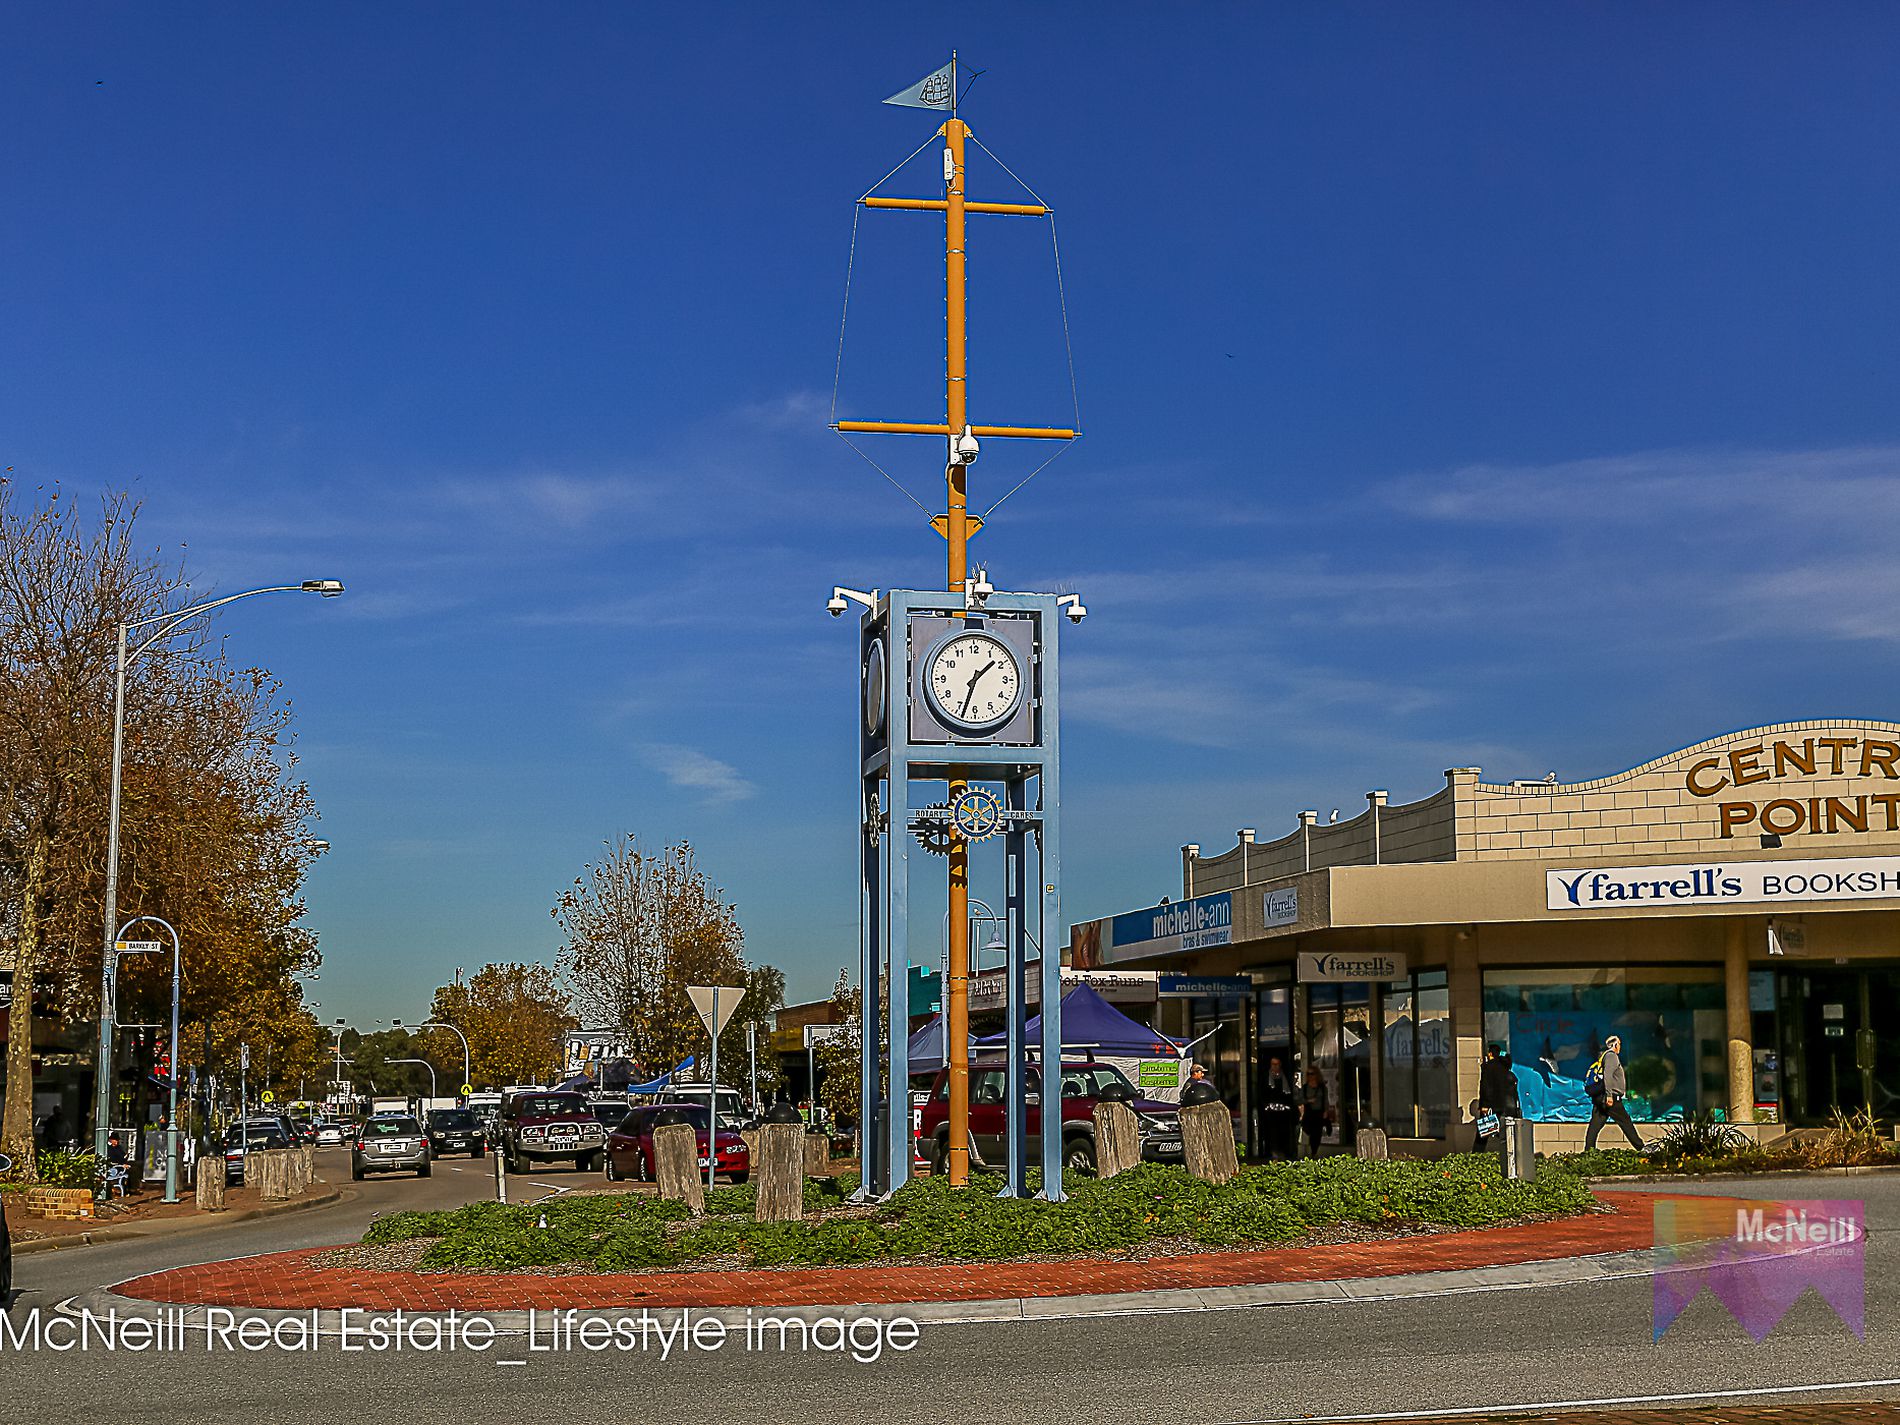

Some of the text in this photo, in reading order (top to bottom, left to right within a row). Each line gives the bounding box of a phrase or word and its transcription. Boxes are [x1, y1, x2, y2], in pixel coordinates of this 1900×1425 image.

[955, 649, 964, 658] 11
[969, 645, 979, 654] 12
[946, 660, 956, 668] 10
[998, 661, 1004, 669] 2
[940, 675, 947, 683] 9
[1002, 676, 1008, 684] 3
[945, 690, 951, 698] 8
[957, 701, 963, 709] 7
[987, 702, 993, 710] 5
[972, 706, 978, 714] 6
[915, 809, 1034, 819] ROTARY CARES
[1718, 793, 1900, 839] POINT
[1589, 868, 1742, 902] farrell's
[1271, 894, 1297, 913] farrell's
[1183, 934, 1195, 949] bras
[1201, 929, 1229, 946] swimwear
[128, 942, 158, 950] BARKLY ST
[1329, 957, 1395, 971] farrell's
[1083, 975, 1106, 987] Fox
[1109, 975, 1144, 987] Runs
